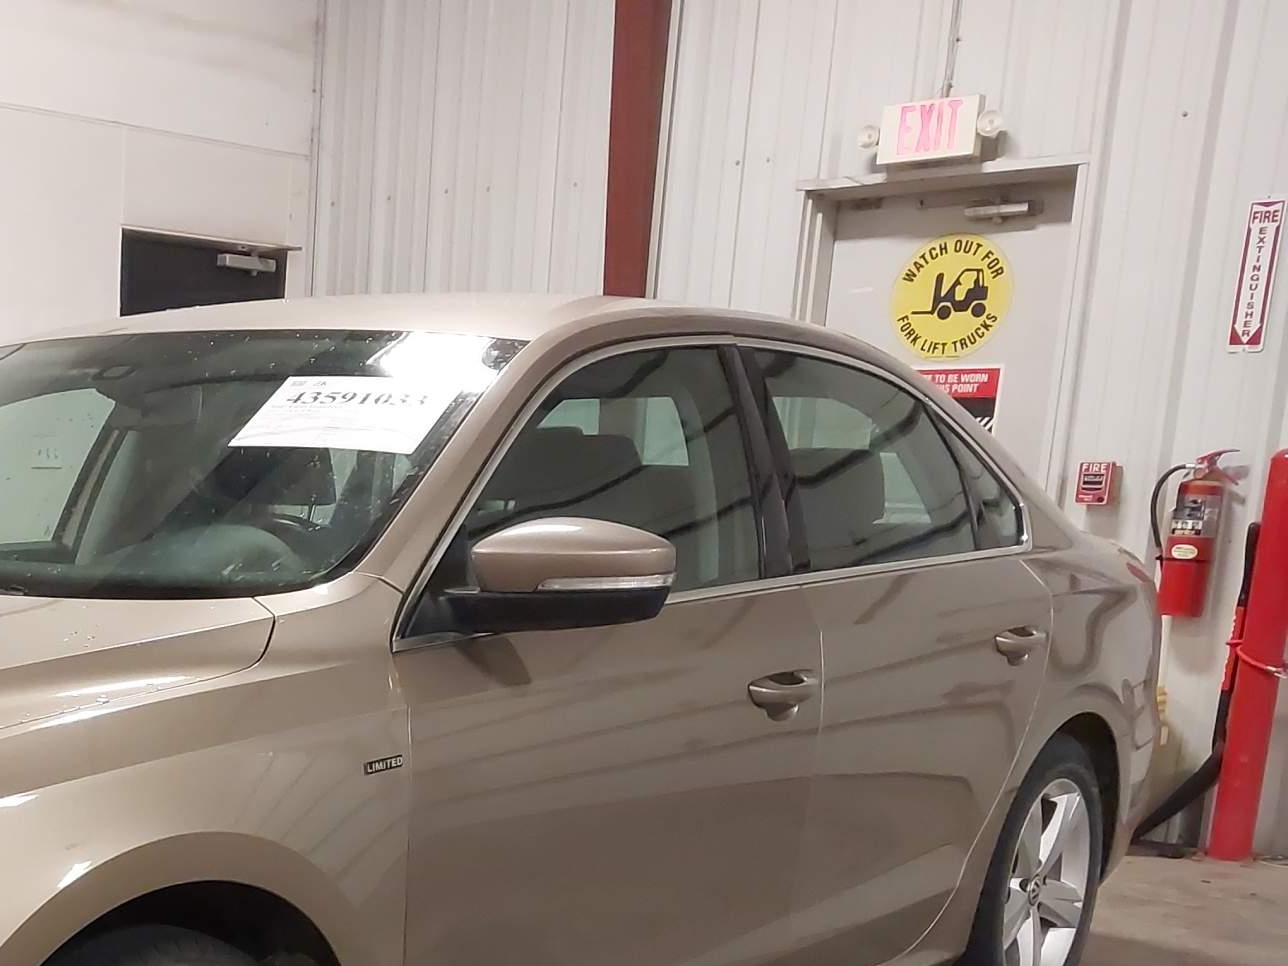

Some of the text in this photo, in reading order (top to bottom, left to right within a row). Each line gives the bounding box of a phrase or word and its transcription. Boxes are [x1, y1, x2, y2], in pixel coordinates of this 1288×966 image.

[896, 99, 964, 156] EXIT
[1252, 209, 1280, 225] FIRE
[902, 239, 1005, 283] WATCH OUT FOR
[1241, 226, 1268, 338] EXTINGUISHER
[896, 312, 998, 355] FORK LIFT TRUCKS
[935, 373, 946, 384] TO
[947, 373, 959, 383] BE
[960, 372, 989, 383] WORN
[952, 383, 980, 393] POINT
[1082, 463, 1108, 473] FIRE
[367, 756, 403, 773] LIMITED
